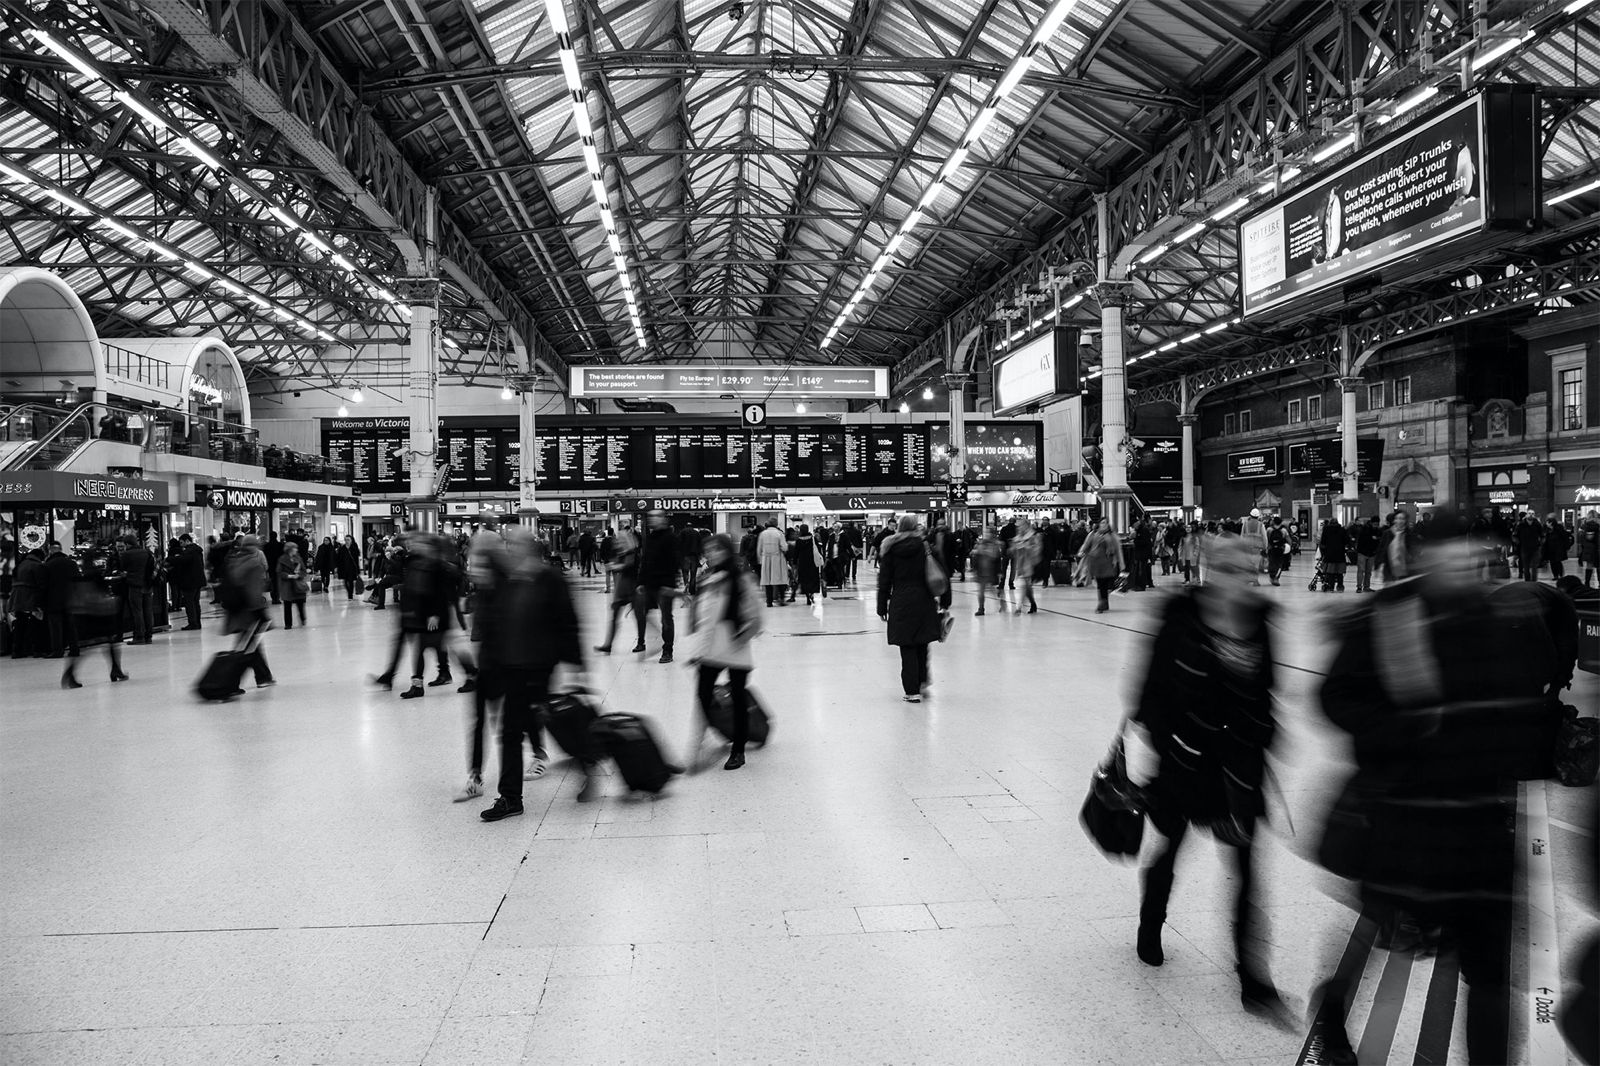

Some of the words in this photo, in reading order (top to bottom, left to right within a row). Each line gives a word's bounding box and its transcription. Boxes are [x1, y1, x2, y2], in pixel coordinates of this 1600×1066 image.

[1344, 188, 1358, 200] Our
[1360, 178, 1376, 193] cost
[1377, 165, 1404, 185] saving
[1405, 156, 1418, 171] SIP
[1420, 140, 1452, 162] Trunks
[1344, 194, 1370, 214] enable
[1371, 188, 1386, 204] you
[1387, 183, 1397, 196] to
[1398, 168, 1424, 188] divert
[1425, 157, 1447, 178] your
[1345, 202, 1383, 226] telephone
[1384, 192, 1403, 208] calls
[1404, 172, 1448, 199] wherever
[1345, 226, 1360, 242] you
[1360, 216, 1380, 232] wish,
[1382, 197, 1424, 223] whenever
[1425, 188, 1442, 206] you
[1444, 176, 1466, 195] wish
[1250, 219, 1280, 240] SPITFIRE
[332, 420, 365, 428] Welcome
[366, 420, 374, 428] to
[374, 419, 410, 428] Victoria
[967, 446, 983, 454] WHEN
[985, 446, 996, 454] YOU
[998, 446, 1009, 454] CAN
[74, 480, 116, 497] NERO
[118, 486, 154, 500] EXPRESS
[227, 490, 267, 507] MONSOON
[1013, 494, 1034, 504] Upper
[1035, 492, 1057, 502] Crust
[391, 504, 401, 513] 10
[654, 500, 705, 509] BURGER
[849, 498, 867, 508] GX
[1587, 625, 1600, 636] RAI
[1536, 997, 1556, 1024] Doodle
